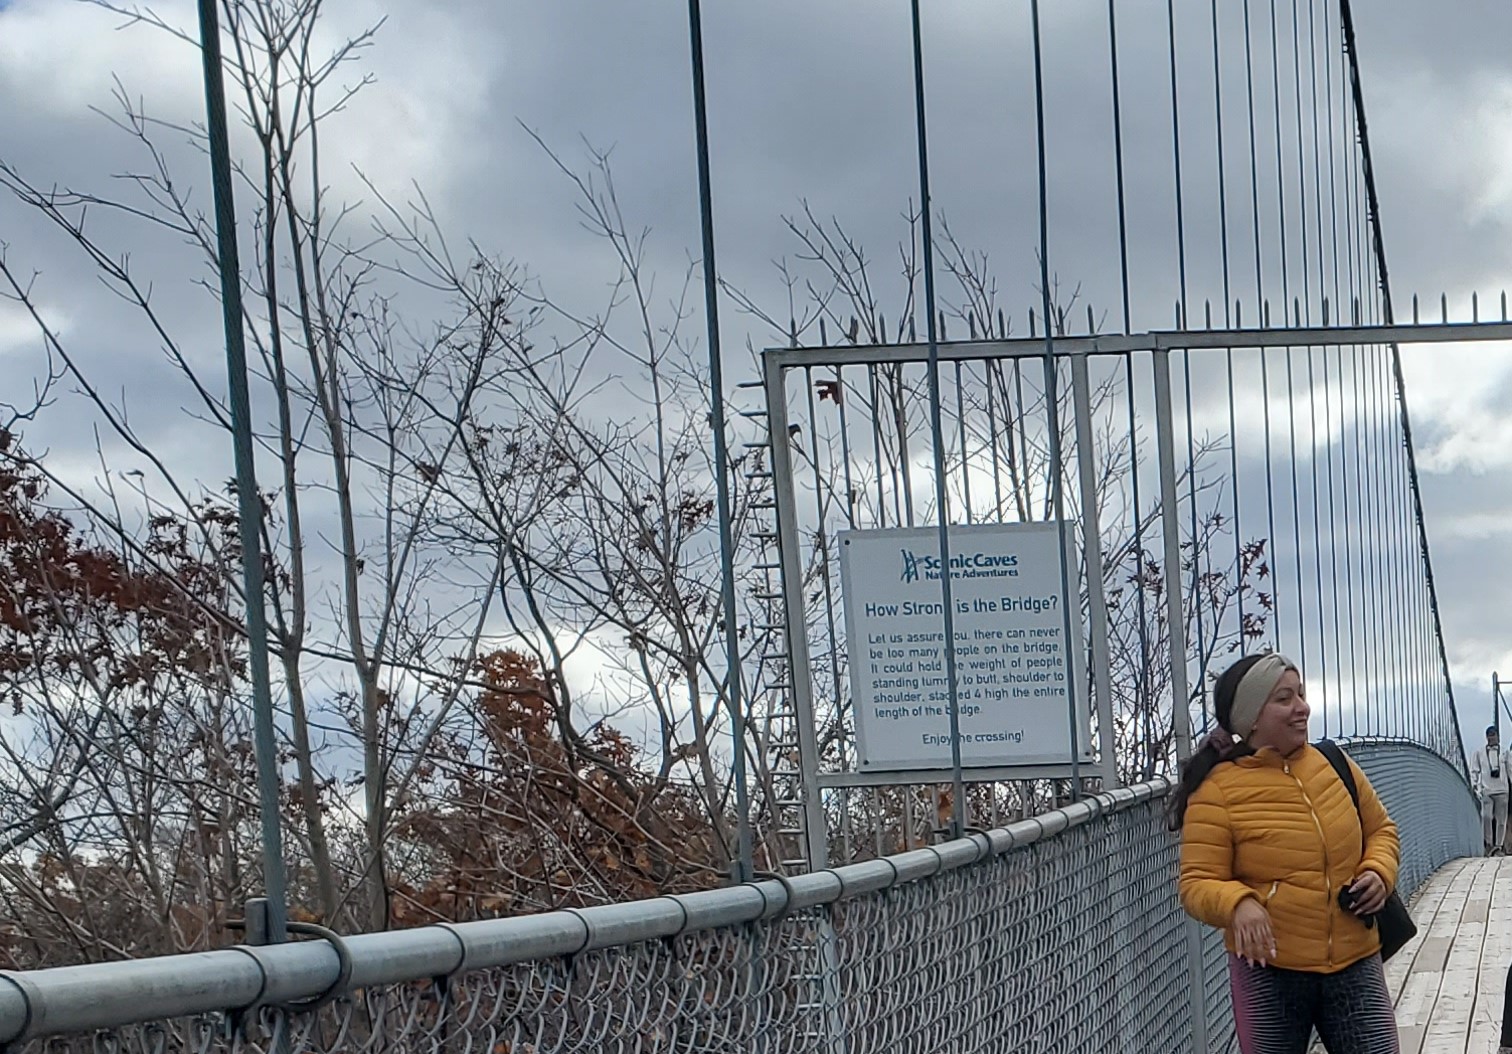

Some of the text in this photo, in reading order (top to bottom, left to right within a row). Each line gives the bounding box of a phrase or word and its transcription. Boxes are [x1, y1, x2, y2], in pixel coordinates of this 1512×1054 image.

[924, 552, 1018, 570] ScnicCaves
[926, 568, 1018, 580] Natre Adventures
[866, 595, 1058, 618] How Stron is the Bridge?
[868, 633, 886, 644] Let
[890, 633, 903, 644] us
[907, 632, 944, 643] assure
[974, 628, 1003, 640] there
[1006, 628, 1026, 639] can
[1030, 626, 1060, 638] never
[869, 648, 883, 660] be
[888, 647, 904, 658] too
[909, 646, 939, 660] many
[944, 644, 980, 659] pople
[984, 644, 998, 655] on
[1002, 642, 1019, 654] the
[871, 663, 878, 674] It
[884, 662, 913, 674] could
[918, 660, 942, 672] hold
[969, 658, 1006, 672] weight
[1011, 657, 1022, 668] of
[1026, 656, 1063, 669] people
[872, 677, 919, 690] standing
[963, 674, 974, 685] to
[1002, 672, 1050, 684] shoulder
[1054, 671, 1064, 682] to
[928, 688, 971, 702] staced
[974, 688, 982, 700] 4
[984, 687, 1009, 701] high
[1012, 686, 1030, 698] the
[1034, 686, 1066, 698] entire
[875, 704, 983, 719] length of the bdge.
[922, 731, 1024, 746] Enjoy he crossing!
